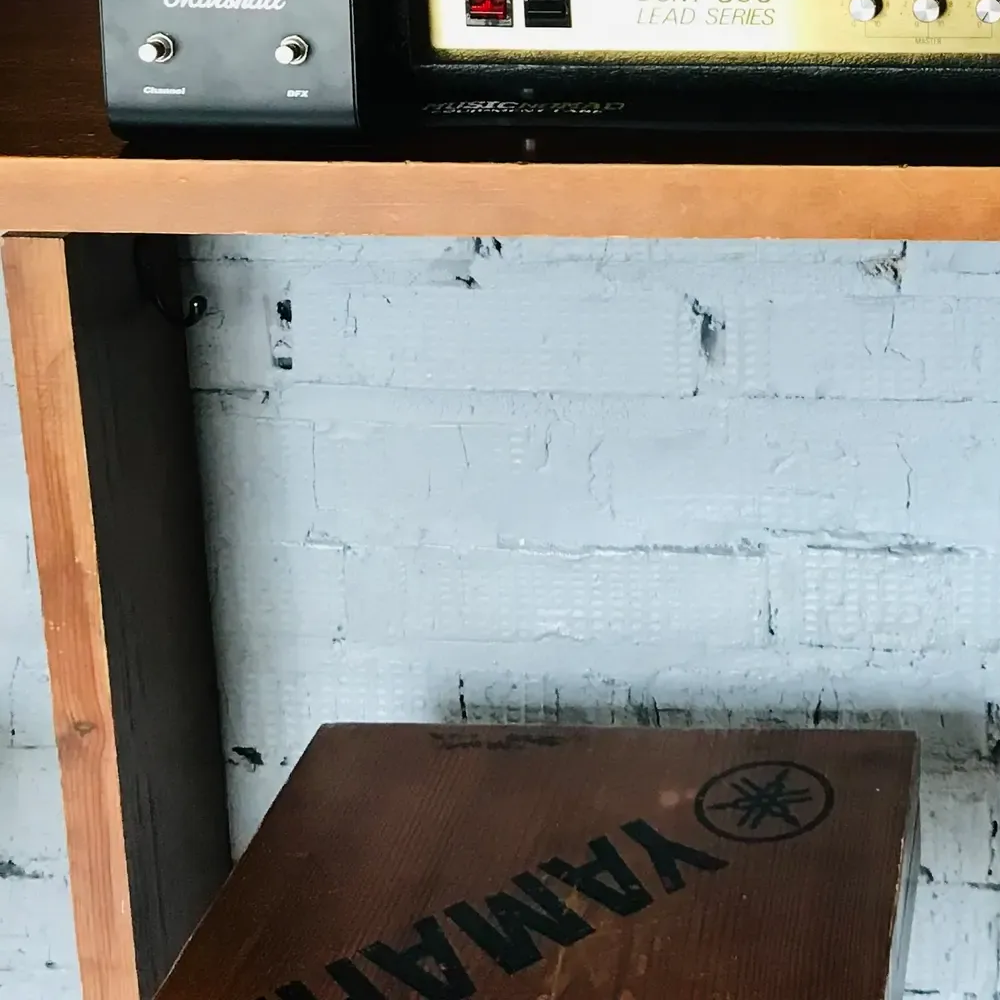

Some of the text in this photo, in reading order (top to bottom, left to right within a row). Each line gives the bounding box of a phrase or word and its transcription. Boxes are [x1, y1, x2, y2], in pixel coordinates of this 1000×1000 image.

[636, 7, 776, 26] LEAD SERIES
[143, 86, 186, 96] Channel
[286, 89, 309, 98] DFX
